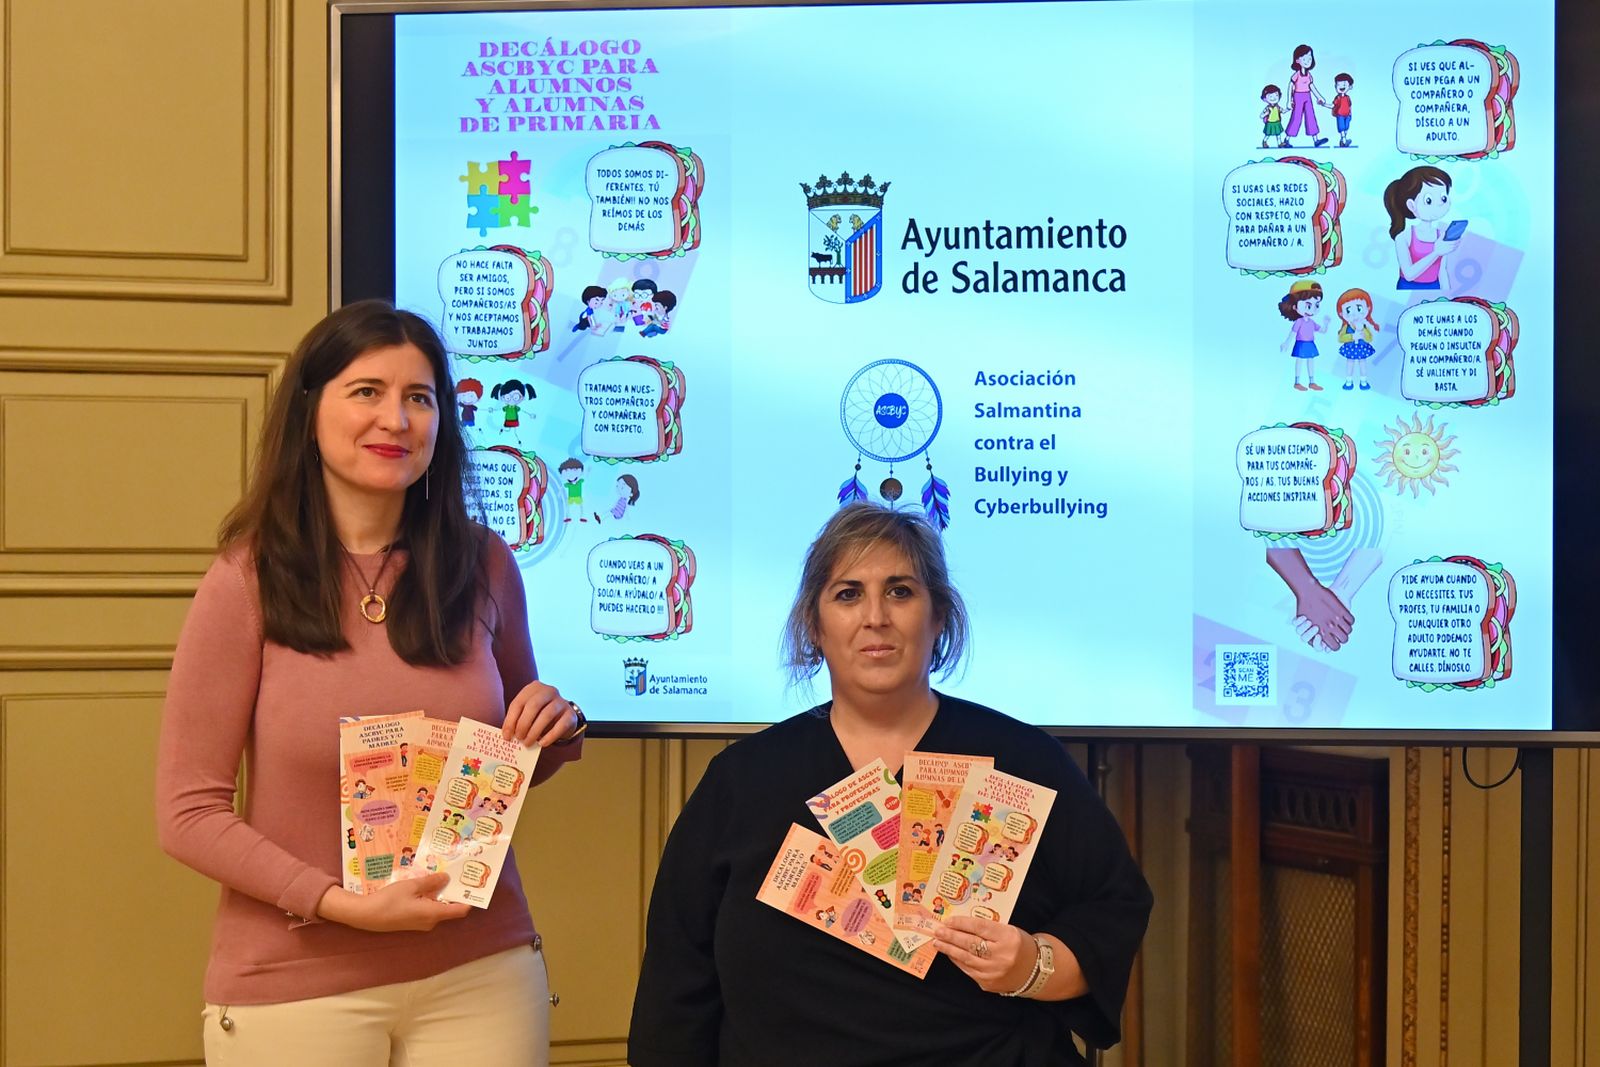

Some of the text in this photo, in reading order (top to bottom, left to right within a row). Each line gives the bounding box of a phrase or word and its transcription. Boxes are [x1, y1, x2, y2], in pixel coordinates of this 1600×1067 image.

[479, 37, 641, 57] DECÁLOGO
[461, 58, 659, 76] ASCBYC PARA
[1409, 61, 1474, 71] SI VES QUE AL-
[1404, 75, 1479, 85] GUIEN PEGA A UN
[488, 77, 632, 94] ALUMNOS
[1411, 88, 1473, 99] COMPAÑERO O
[476, 96, 644, 113] Y ALUMNAS
[1415, 101, 1470, 113] COMPAÑERA,
[459, 114, 661, 132] DE PRIMARIA
[1416, 116, 1469, 127] DÍSELO A UN
[1426, 132, 1459, 141] ADULTO.
[597, 169, 668, 179] TODOS SOMOS DI-
[1232, 184, 1307, 193] SI USAS LAS REDES
[1237, 197, 1304, 207] SOCIALES, HAZLO
[603, 207, 662, 218] REÍMOS DE LOS
[1236, 211, 1305, 221] CON RESPETO, NO
[618, 221, 645, 231] DEMÁS
[1236, 223, 1306, 233] PARA DAÑAR A UN
[901, 217, 1127, 257] Ayuntamiento
[470, 261, 489, 269] HACE
[492, 261, 513, 269] FALTA
[477, 274, 509, 284] AMIGOS,
[902, 261, 1126, 294] de Salamanca
[454, 287, 514, 296] PERO SI SOMOS
[452, 298, 516, 309] COMPAÑEROS/AS
[456, 313, 471, 321] NOS
[475, 314, 519, 322] ACEPTAMOS
[1413, 316, 1423, 324] NO
[1437, 315, 1454, 323] UNAS
[1457, 315, 1461, 323] A
[1465, 315, 1477, 323] LOS
[1418, 327, 1441, 337] DEMÁS
[467, 339, 497, 348] JUNTOS
[1416, 367, 1476, 377] SÉ VALIENTE Y DI
[974, 370, 1076, 386] Asociación
[585, 384, 622, 393] TRATAMOS
[631, 385, 655, 394] NUES-
[585, 396, 654, 407] TROS COMPAÑEROS
[974, 403, 1081, 418] Salmantina
[594, 424, 643, 433] CON RESPETO.
[974, 434, 1056, 450] contra el
[1246, 443, 1318, 455] SÉ UN BUEN EJEMPLO
[1247, 458, 1316, 470] PARA TUS COMPAÑE-
[485, 477, 495, 485] NO
[498, 477, 513, 485] SON
[974, 467, 1068, 486] Bullying y
[1248, 492, 1318, 502] ACCIONES INSPIRAN.
[974, 498, 1107, 518] Cyberbullying
[507, 517, 515, 525] ES
[1402, 575, 1476, 584] PIDE AYUDA CUANDO
[1405, 590, 1413, 599] LO
[1459, 590, 1473, 599] TUS
[1399, 605, 1480, 615] PROFES, TU FAMILIA O
[1409, 619, 1471, 628] CUALQUIER OTRO
[1408, 634, 1472, 643] ADULTO PODEMOS
[1450, 649, 1459, 657] NO
[1463, 649, 1471, 657] TE
[1409, 660, 1471, 672] CALLES. DÍNOSLO.
[649, 675, 707, 684] Ayuntamiento
[1238, 674, 1254, 682] ME
[649, 685, 707, 694] de Salamanca
[363, 721, 400, 731] DECÁLOGO
[359, 730, 384, 738] ASCBYC
[362, 736, 389, 744] PADRES
[369, 740, 398, 749] MADRES
[841, 776, 880, 802] PROFESORES
[840, 786, 880, 812] PROFESORAS
[886, 798, 898, 808] STOP
